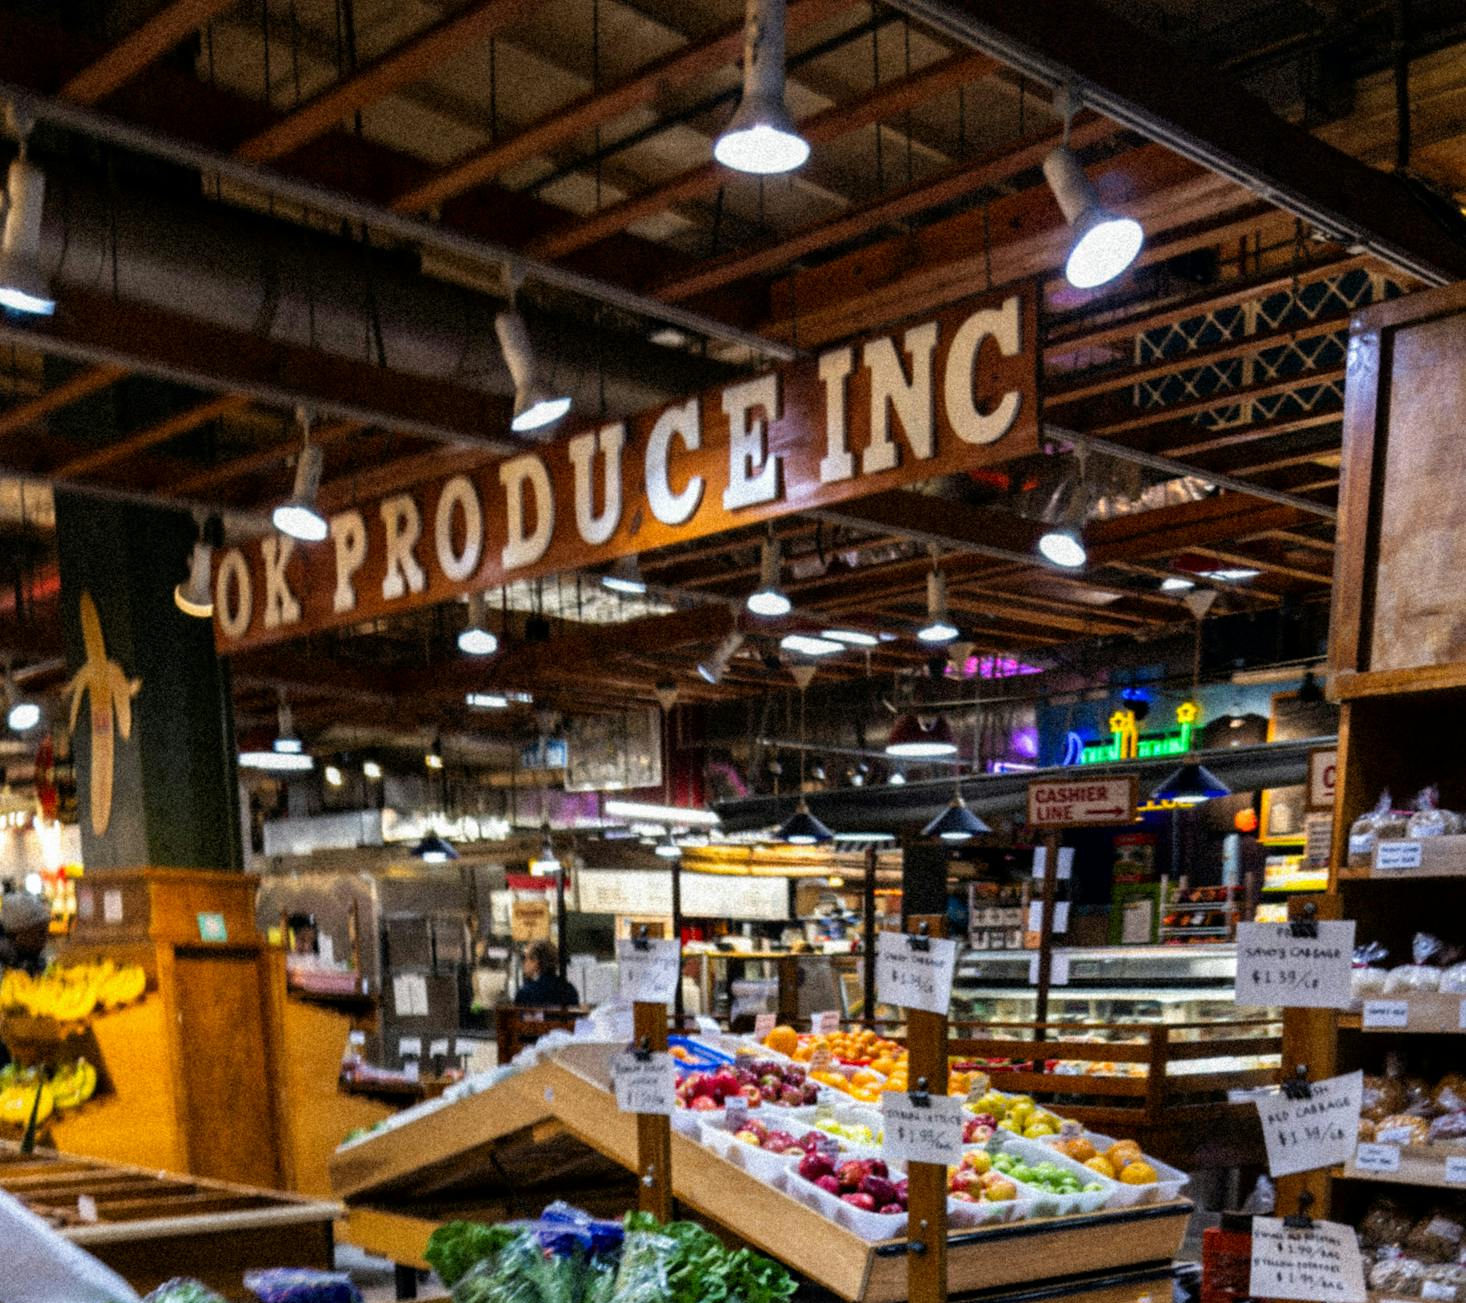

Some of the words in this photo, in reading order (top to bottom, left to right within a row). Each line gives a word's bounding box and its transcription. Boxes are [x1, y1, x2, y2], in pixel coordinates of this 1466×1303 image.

[215, 532, 303, 638] OK
[331, 372, 790, 613] PRODUCE
[817, 295, 1023, 484] INC
[1036, 786, 1107, 803] CASHIER
[1037, 805, 1073, 820] LINE
